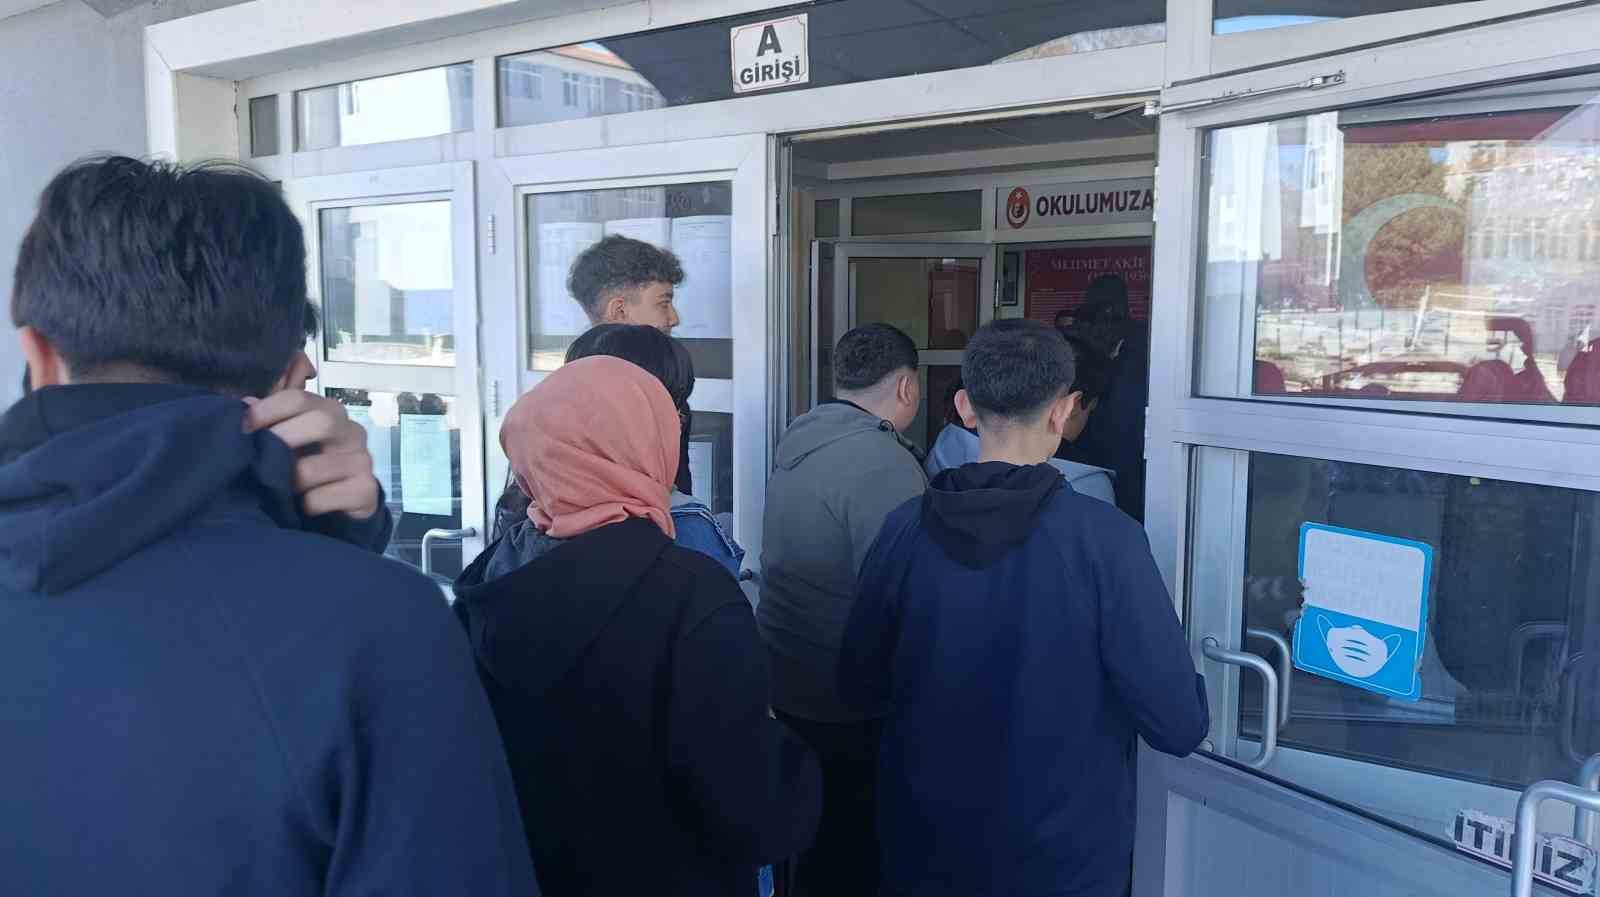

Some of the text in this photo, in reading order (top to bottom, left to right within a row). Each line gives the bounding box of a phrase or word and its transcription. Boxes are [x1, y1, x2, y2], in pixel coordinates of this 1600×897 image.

[756, 24, 782, 57] A
[740, 55, 800, 84] GİRİŞİ
[1036, 189, 1154, 217] OKULUMUZA
